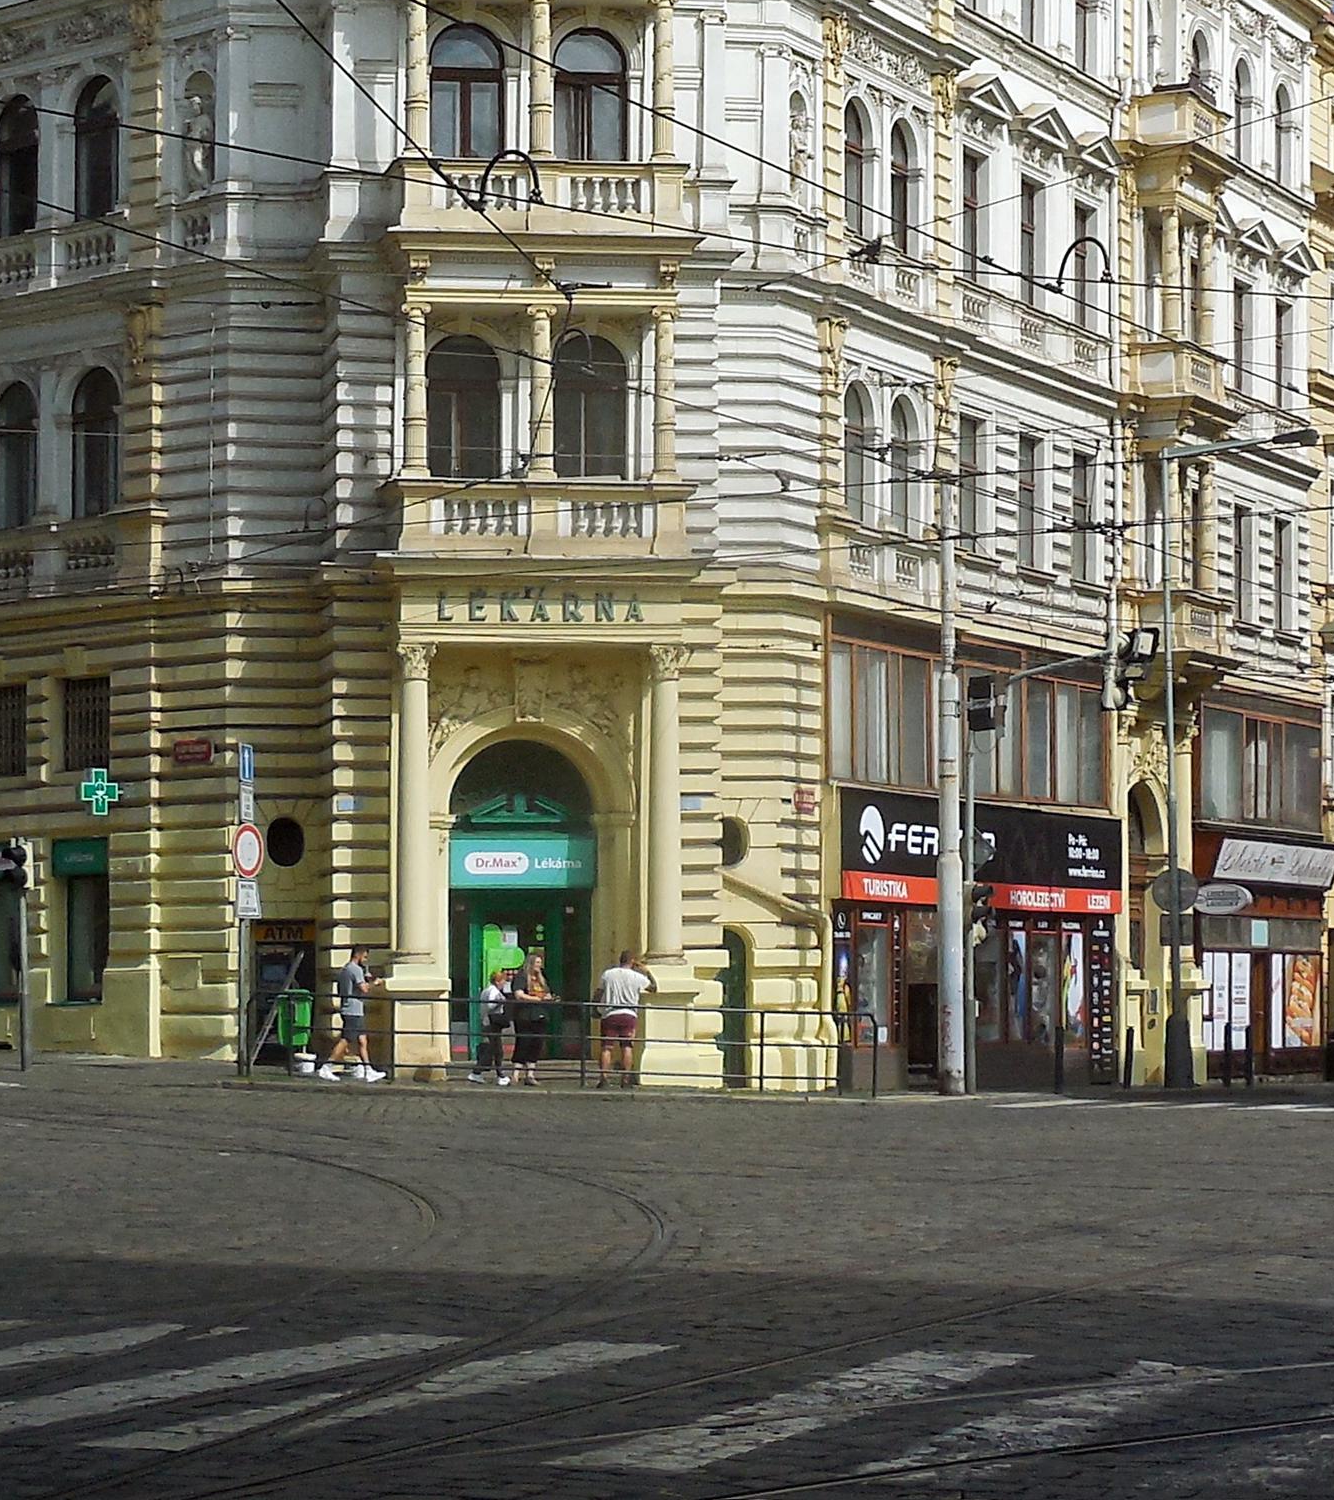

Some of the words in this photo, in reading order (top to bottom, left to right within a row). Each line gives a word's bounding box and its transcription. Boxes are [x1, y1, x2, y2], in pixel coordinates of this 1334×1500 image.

[862, 877, 908, 899] TURISTIKA
[1010, 889, 1066, 909] HOROLEZECTVÍ
[263, 925, 304, 941] ATM
